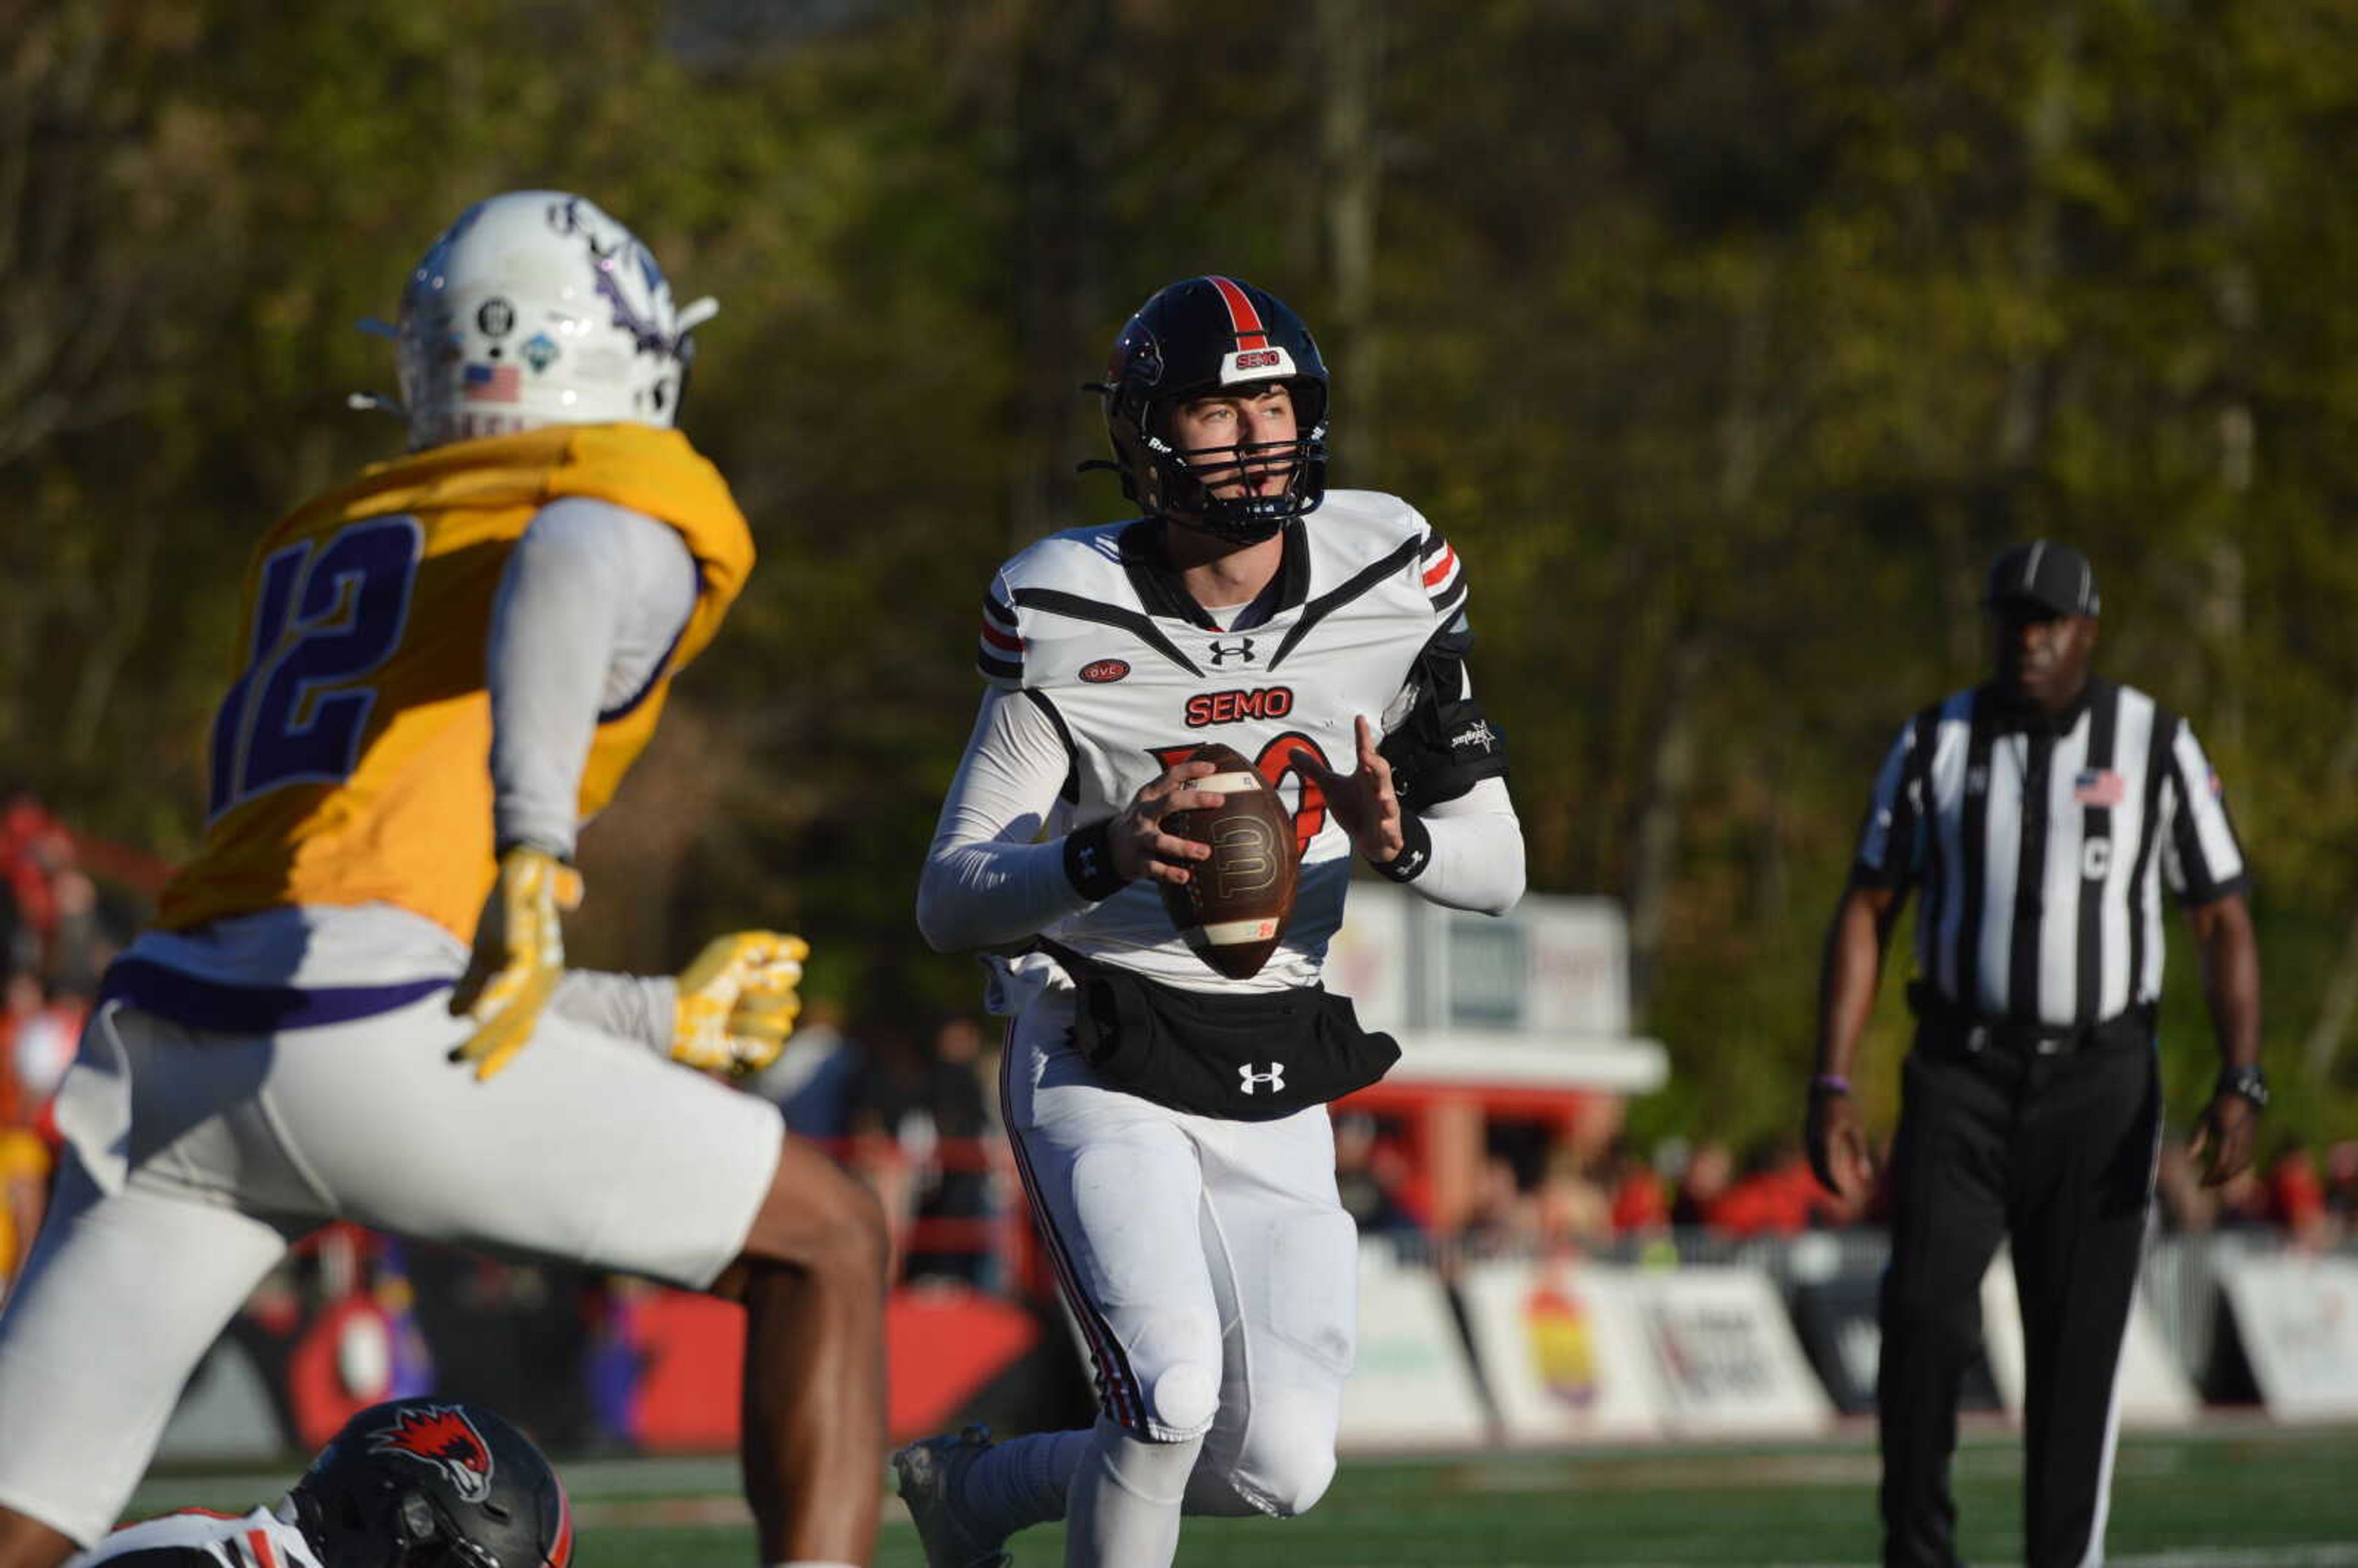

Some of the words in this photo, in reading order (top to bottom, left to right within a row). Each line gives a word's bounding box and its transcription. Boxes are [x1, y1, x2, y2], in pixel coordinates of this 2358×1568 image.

[1236, 351, 1280, 370] SEMO
[208, 513, 425, 826] 12
[1185, 686, 1293, 729] SEMO
[2083, 837, 2113, 880] C
